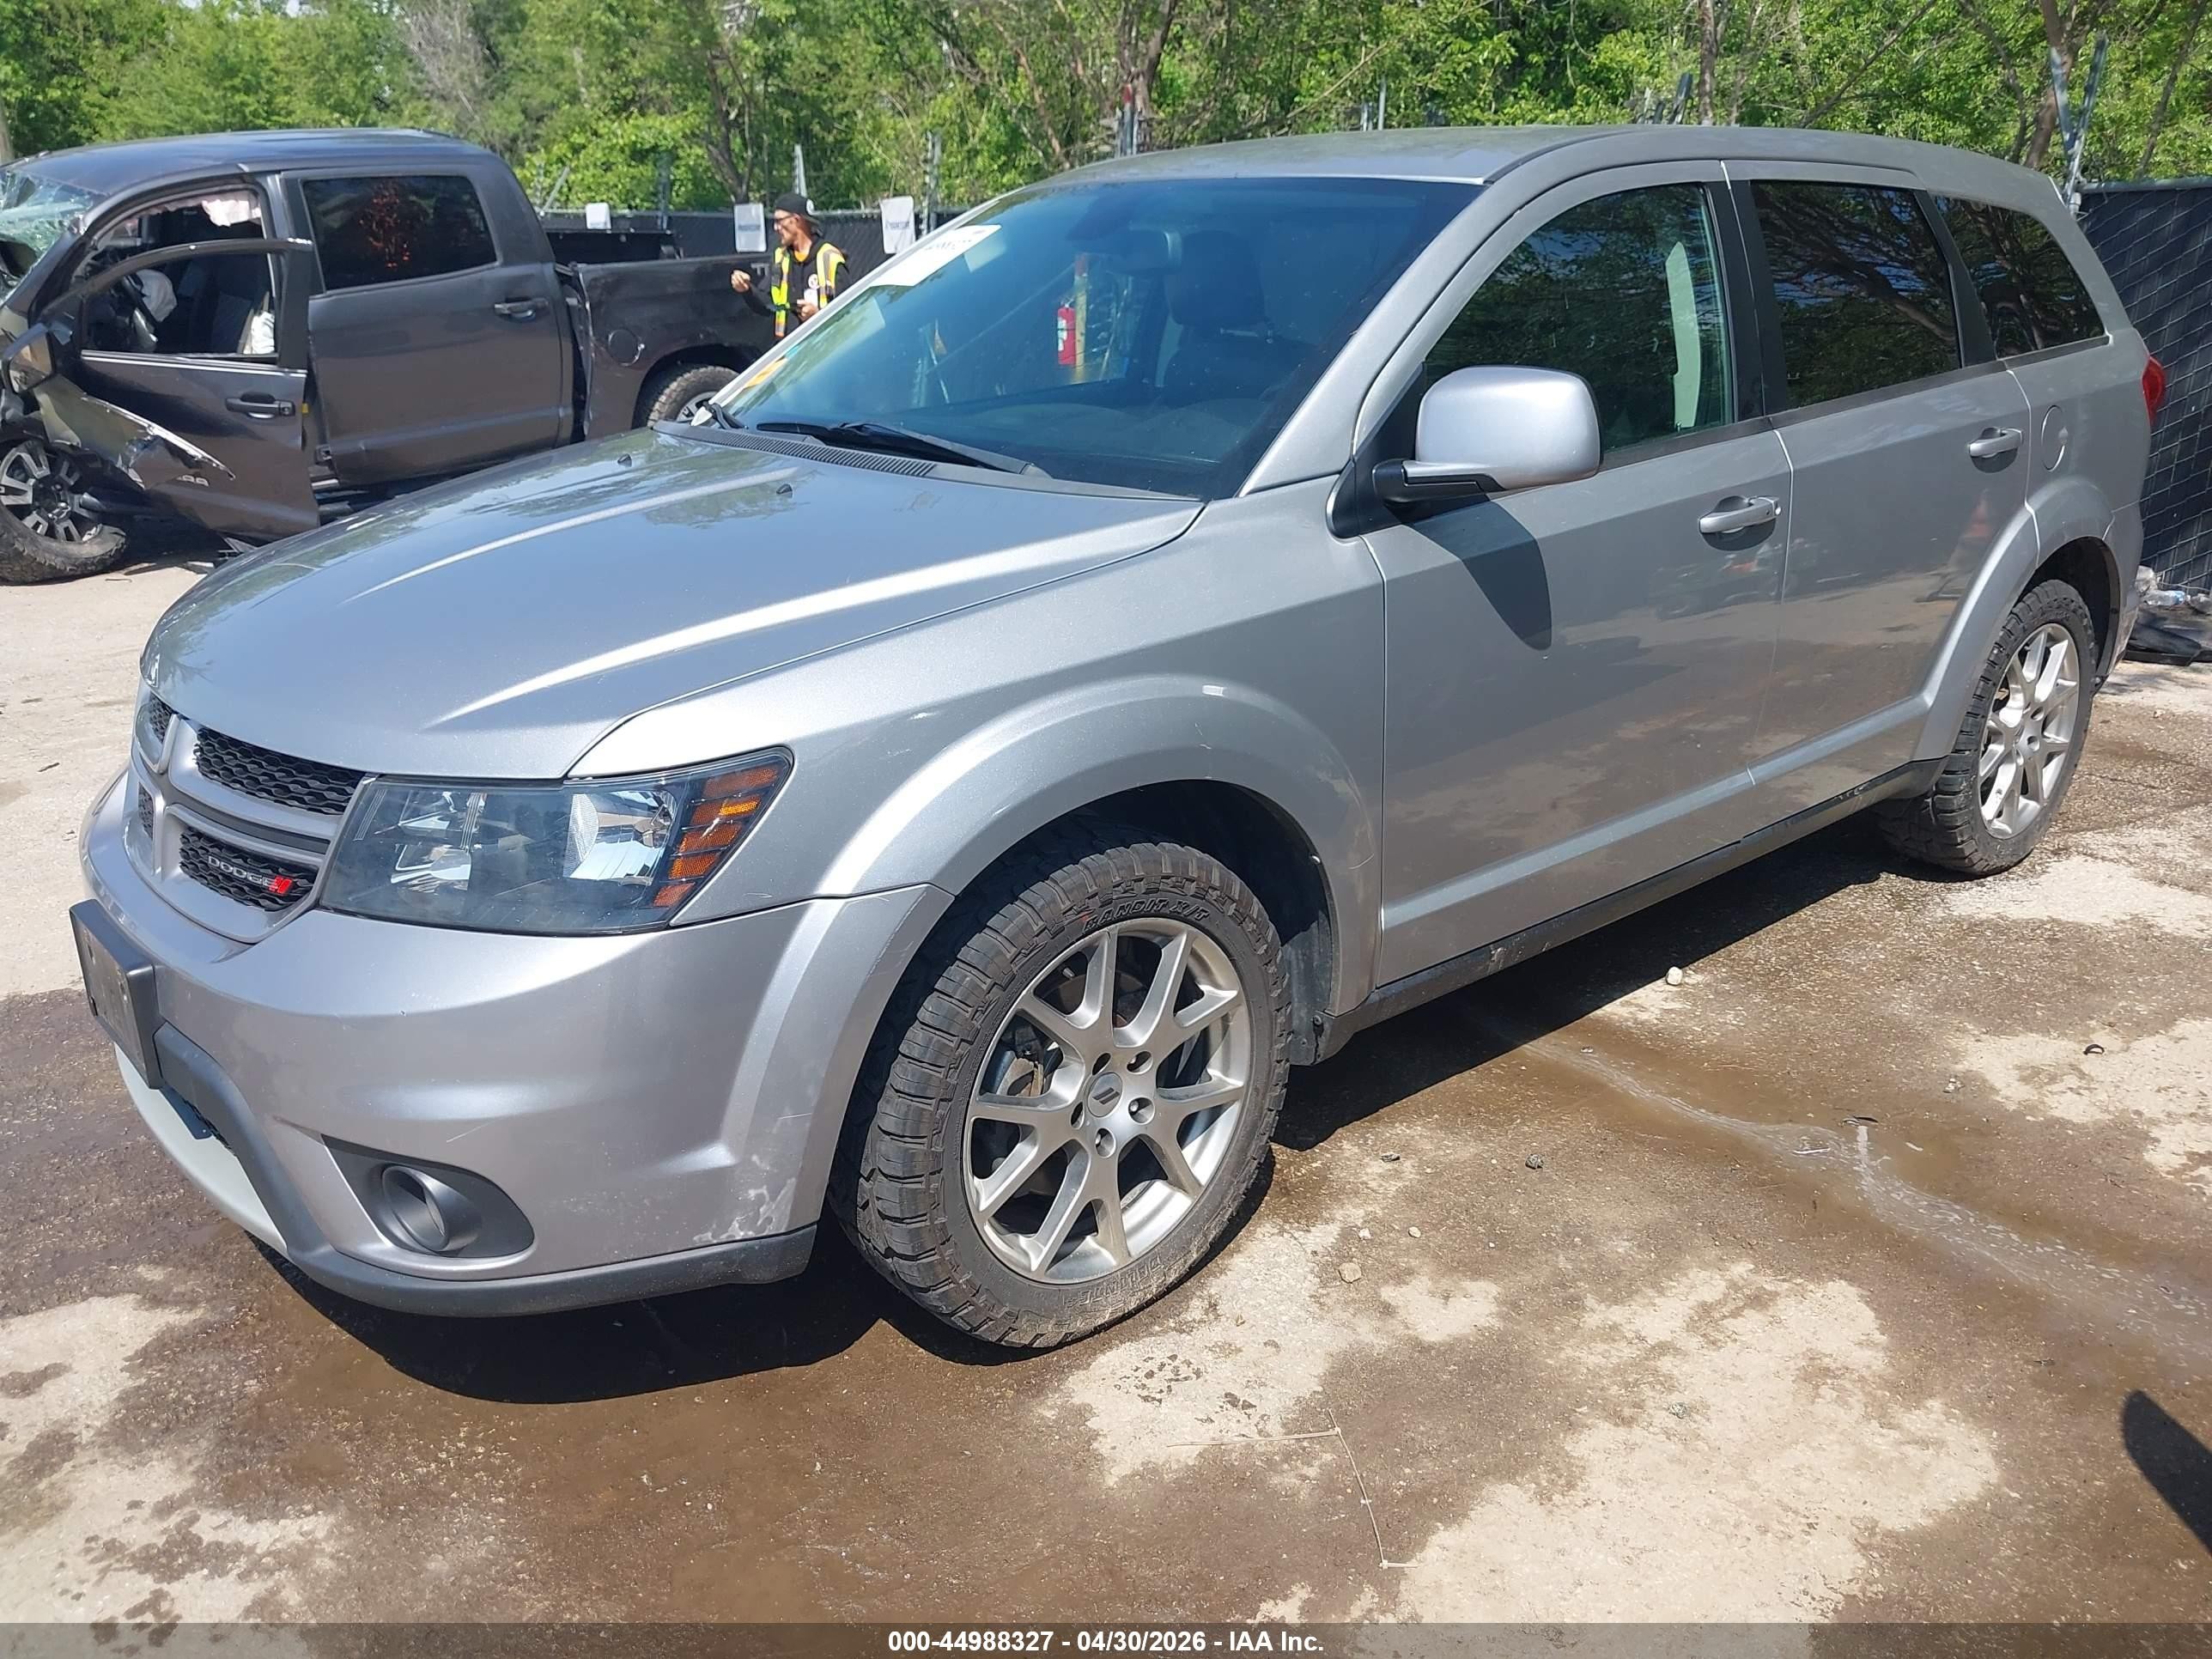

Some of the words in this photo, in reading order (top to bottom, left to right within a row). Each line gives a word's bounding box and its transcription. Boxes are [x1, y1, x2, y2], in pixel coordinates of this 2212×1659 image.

[207, 854, 278, 890] DODGE
[1083, 897, 1169, 933] BANDIT
[1170, 899, 1210, 921] X/T
